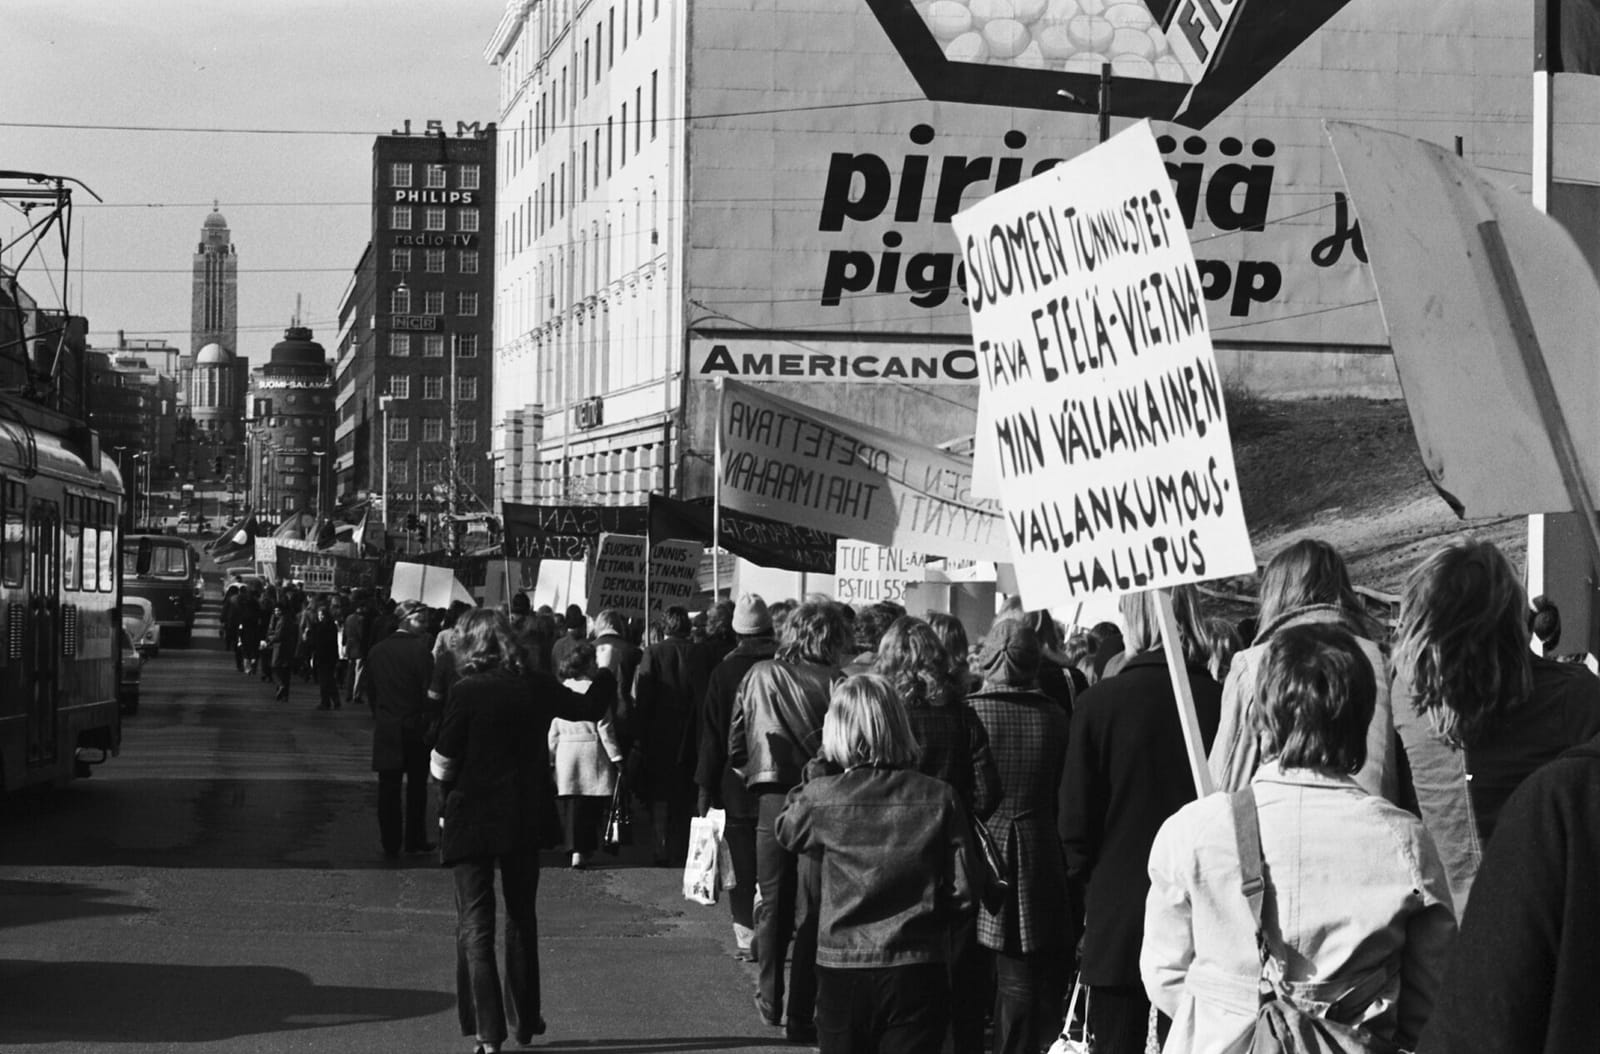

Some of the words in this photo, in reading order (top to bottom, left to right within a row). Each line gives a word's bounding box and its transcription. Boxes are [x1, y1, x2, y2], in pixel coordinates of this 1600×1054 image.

[1177, 0, 1236, 64] FI
[818, 123, 1275, 232] piriää
[395, 190, 473, 203] PHILIPS
[395, 233, 443, 246] radio
[453, 234, 472, 246] TV
[967, 205, 1068, 312] SUOMEN
[395, 317, 435, 329] NCR
[980, 340, 1032, 391] TAVA
[995, 406, 1045, 479] MIN
[1050, 357, 1222, 465] VÄLIAIKAINEN
[597, 559, 634, 573] TETTAVA
[639, 562, 695, 578] VETNAMIN
[602, 542, 643, 557] SUOMEN
[653, 545, 693, 561] UNNUS-
[840, 547, 871, 571] TUE
[1064, 529, 1206, 597] HALLITUS
